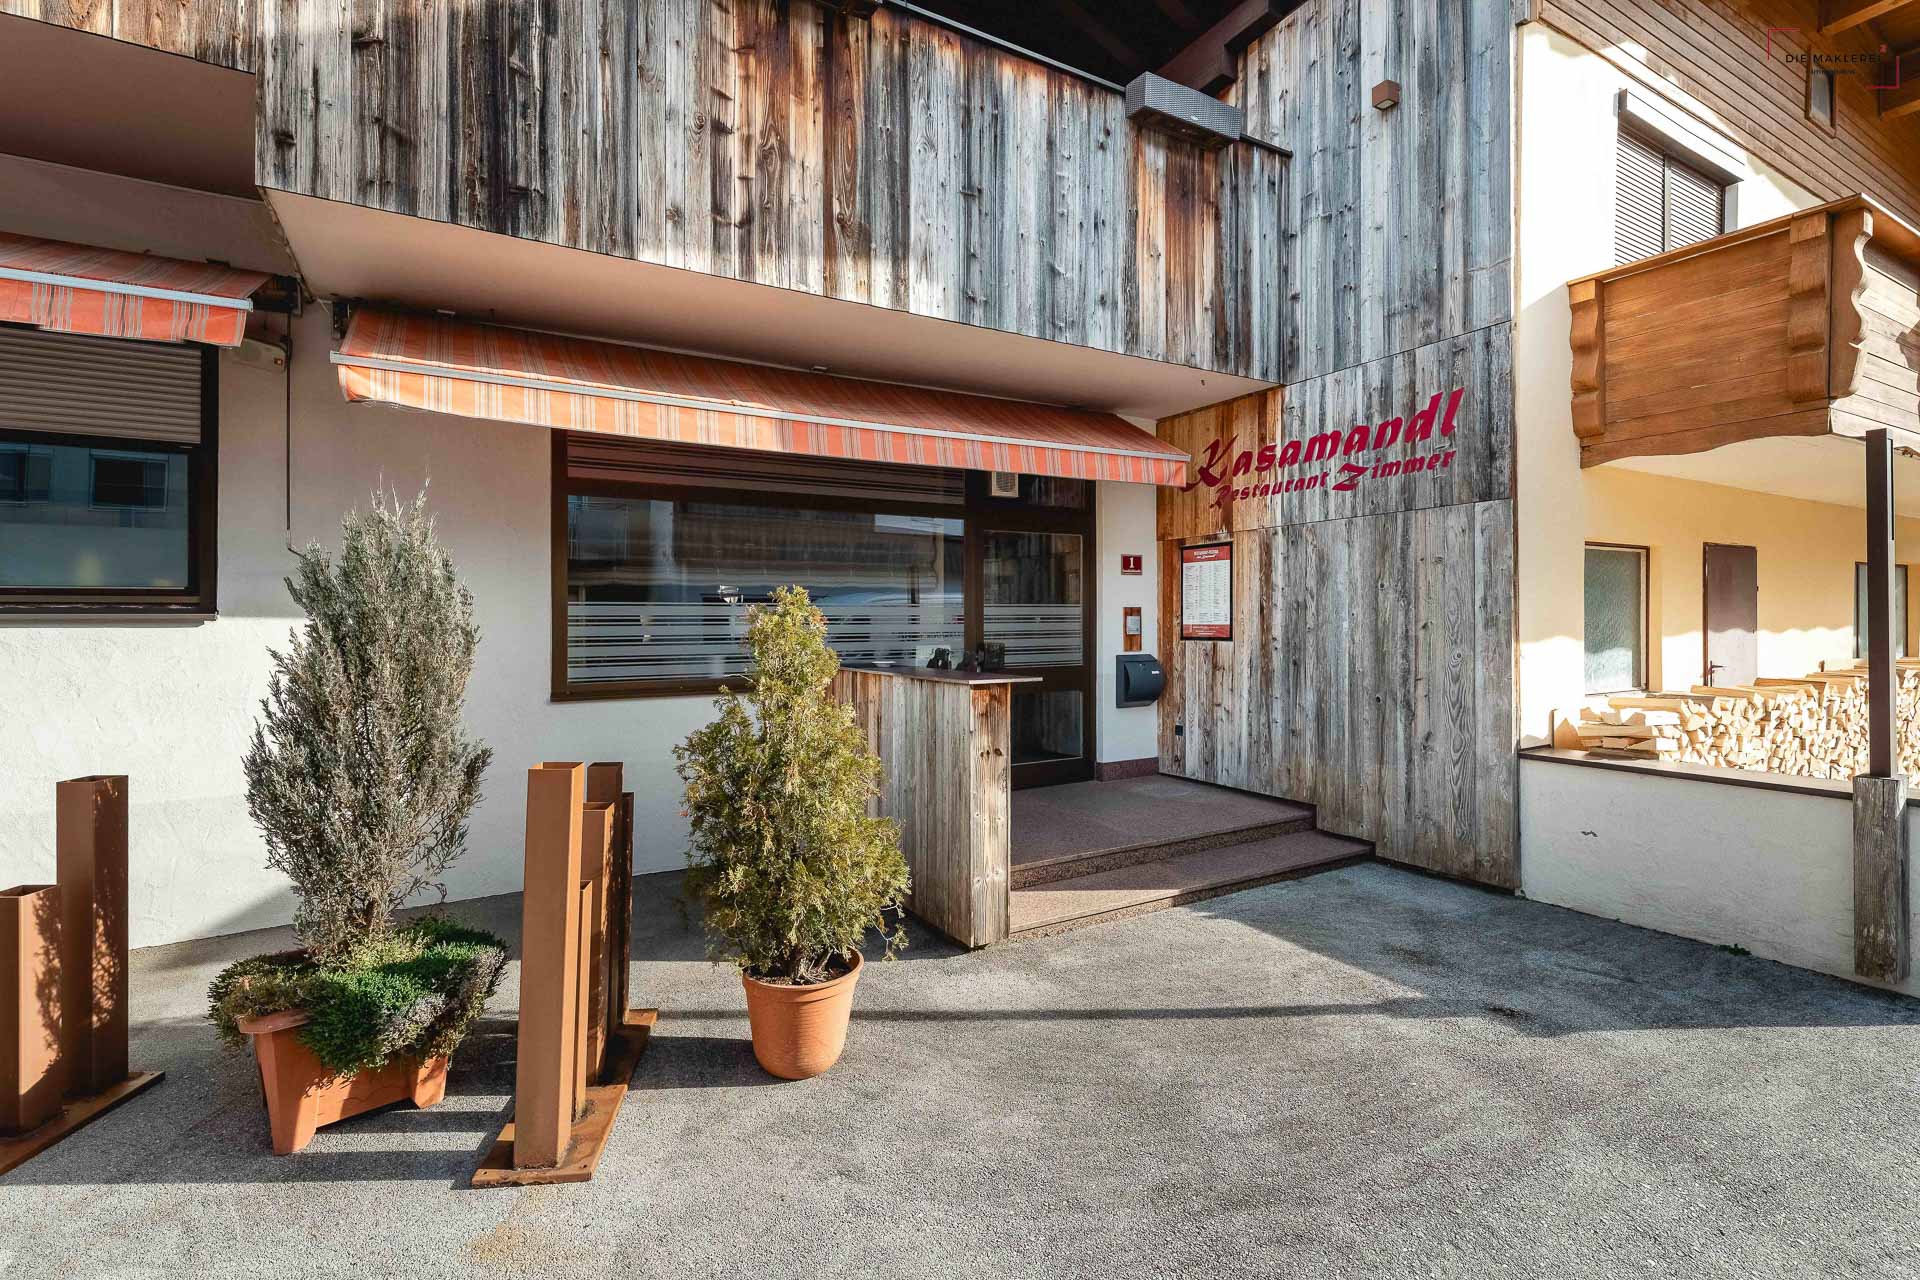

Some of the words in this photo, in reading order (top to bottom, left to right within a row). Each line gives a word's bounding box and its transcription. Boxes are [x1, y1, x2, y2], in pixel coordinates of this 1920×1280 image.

[1180, 387, 1465, 492] Kasamandl
[1209, 471, 1329, 509] Restaurant
[1332, 450, 1457, 491] Zimmer
[1129, 557, 1135, 569] 1
